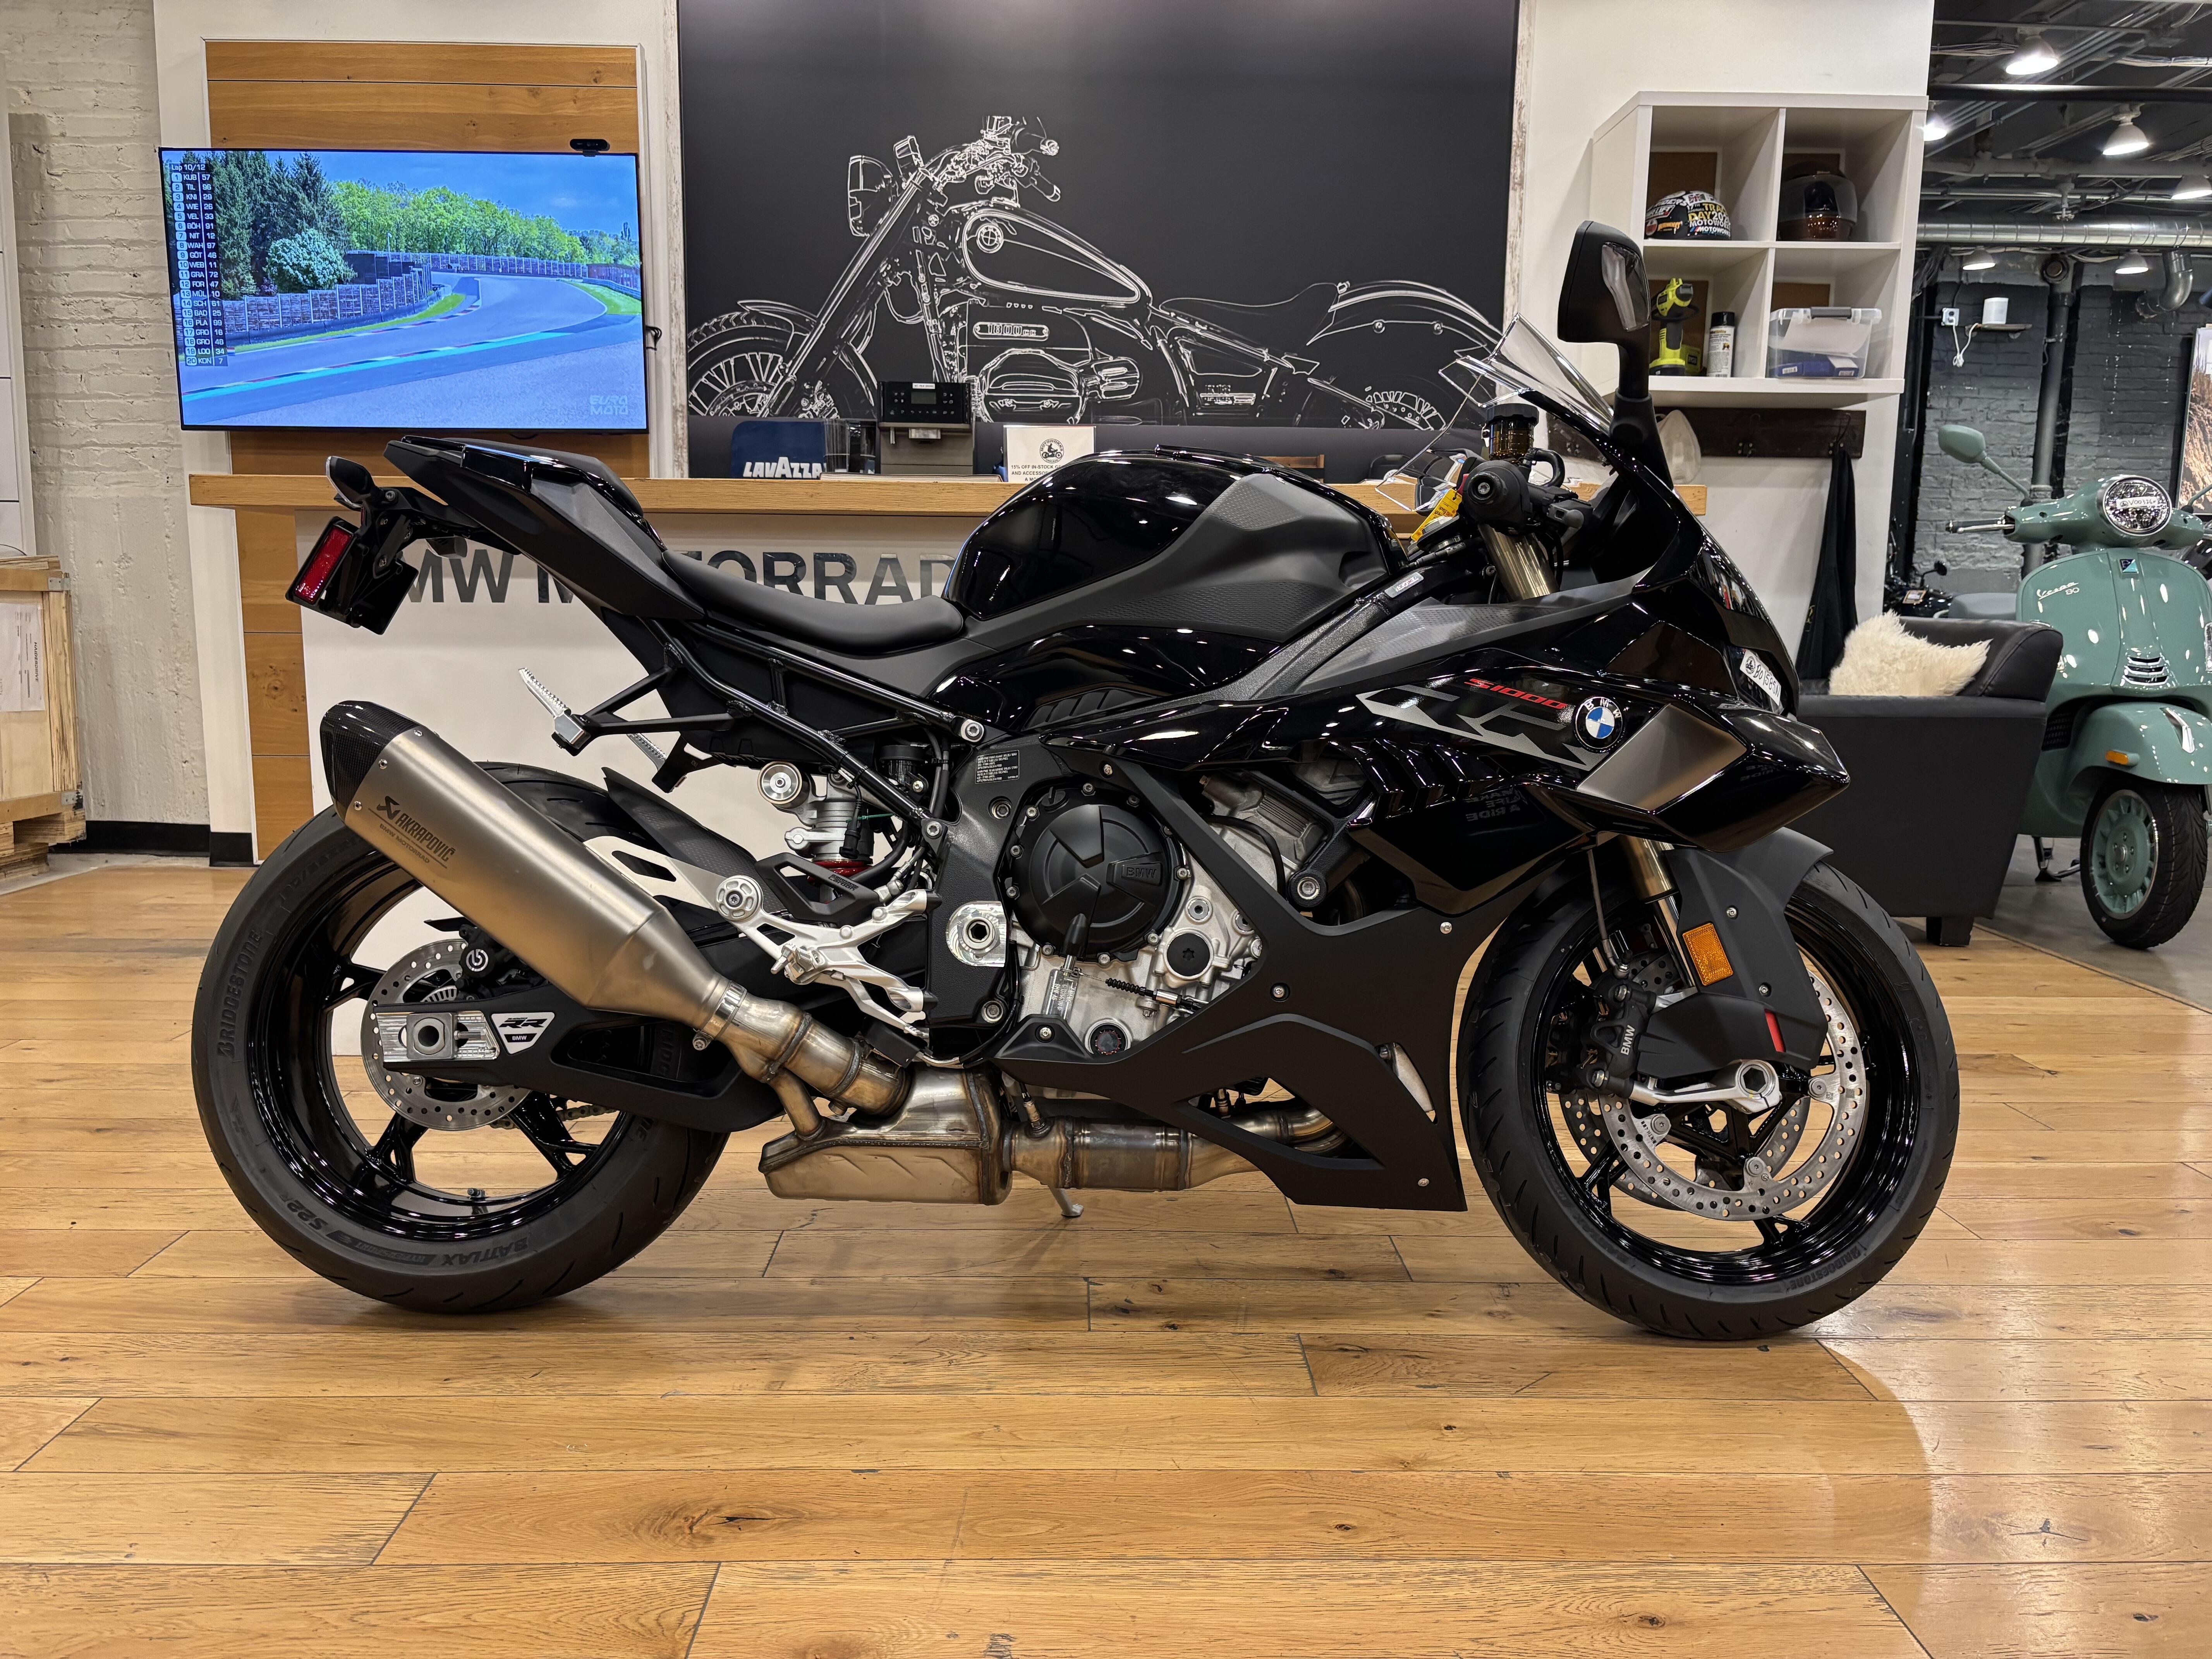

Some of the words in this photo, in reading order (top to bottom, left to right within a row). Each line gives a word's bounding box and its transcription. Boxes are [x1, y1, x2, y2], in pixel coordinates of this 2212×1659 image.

[1688, 211, 1711, 221] DAY
[988, 324, 1036, 336] 1800cc
[590, 405, 628, 416] MOTO
[1041, 440, 1063, 452] MOTOWORKS
[743, 457, 824, 478] LAVAZZA
[2037, 582, 2079, 600] Vespa
[1753, 665, 1780, 697] B01585N
[1464, 678, 1568, 709] S1000
[380, 824, 396, 837] BMW
[396, 835, 430, 864] MOTORRAD
[1127, 867, 1157, 878] BMW
[217, 930, 262, 1058] BRIDGESTONE
[498, 1018, 548, 1029] RR
[1620, 1025, 1635, 1055] BMW
[441, 1237, 529, 1266] BATTLAX
[1789, 1245, 1861, 1290] BRIDGESTONE
